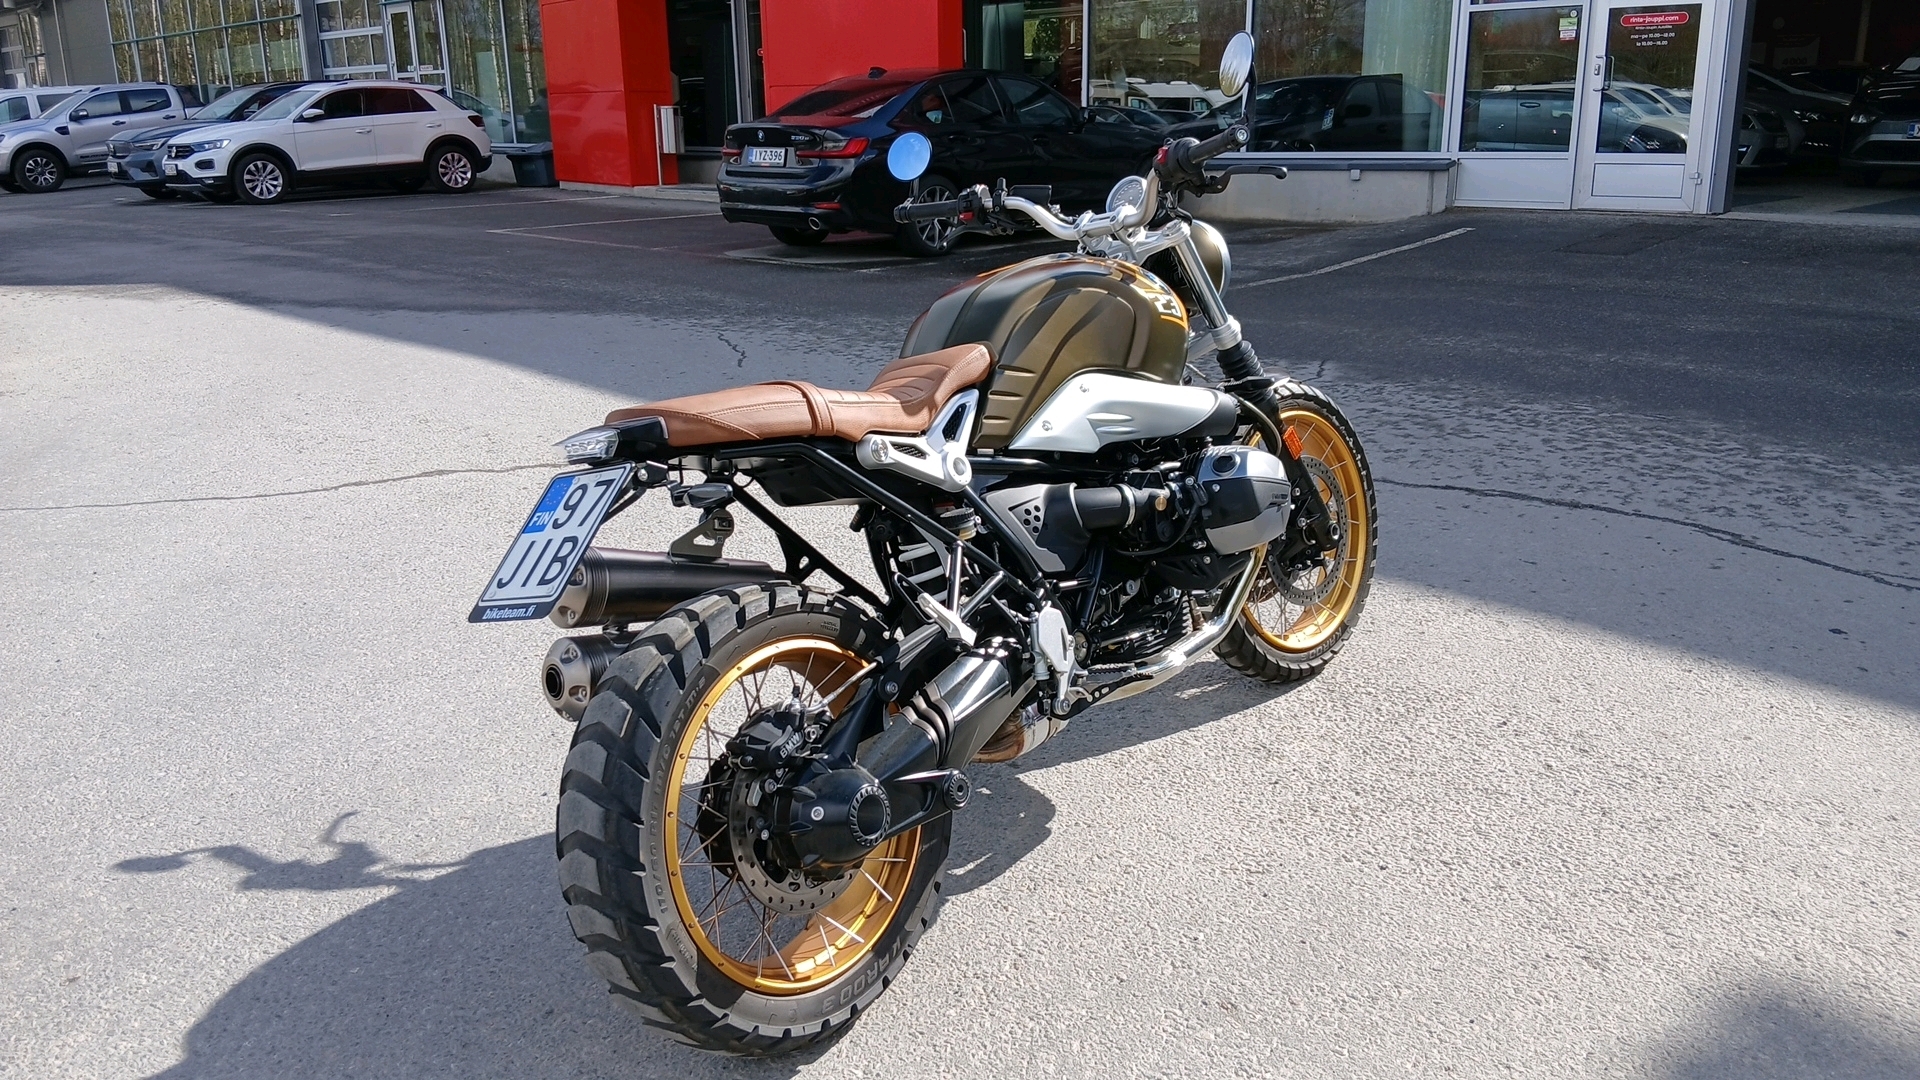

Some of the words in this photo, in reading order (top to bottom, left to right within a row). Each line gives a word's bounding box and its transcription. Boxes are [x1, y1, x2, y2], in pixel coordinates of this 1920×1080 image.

[1630, 15, 1679, 23] rinta-jouppi.com
[754, 150, 783, 161] IYZ-396
[552, 478, 617, 530] 97
[529, 510, 554, 527] FIN
[496, 535, 579, 590] JIB
[482, 604, 536, 621] biketeam.fi
[779, 732, 800, 759] BMW
[839, 935, 902, 1006] KAROO
